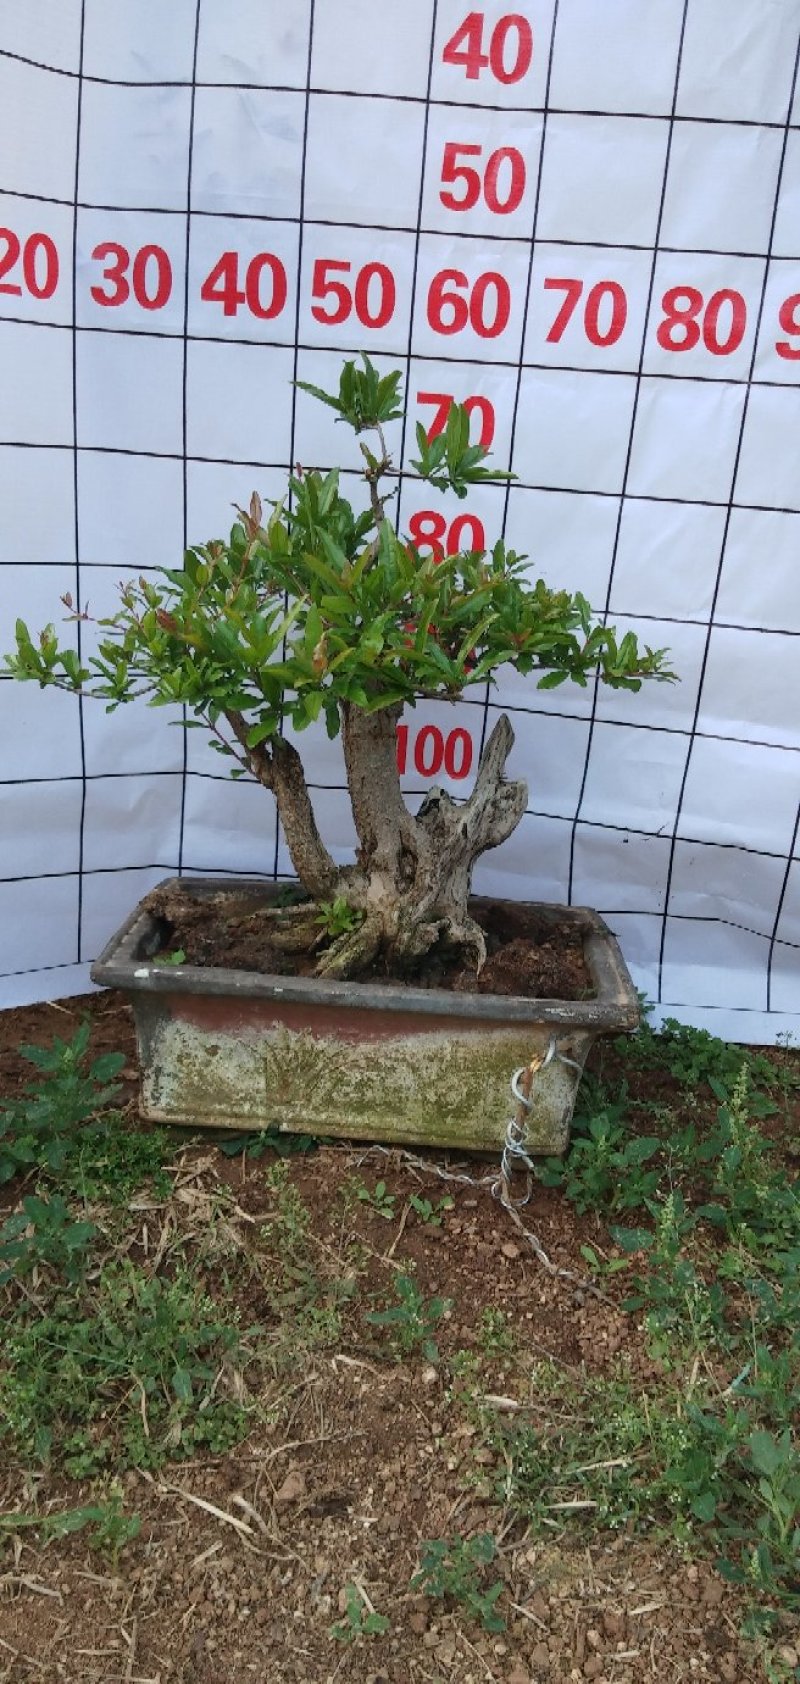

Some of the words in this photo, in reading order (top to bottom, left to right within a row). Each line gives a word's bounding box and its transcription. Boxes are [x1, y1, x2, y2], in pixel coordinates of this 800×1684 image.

[442, 13, 532, 84] 40
[439, 142, 526, 214] 50
[90, 242, 172, 310] 30
[201, 251, 287, 319] 40
[311, 259, 396, 329] 50
[426, 269, 511, 339] 60
[543, 278, 627, 347] 70
[657, 286, 747, 356] 80
[395, 725, 473, 780] 100
